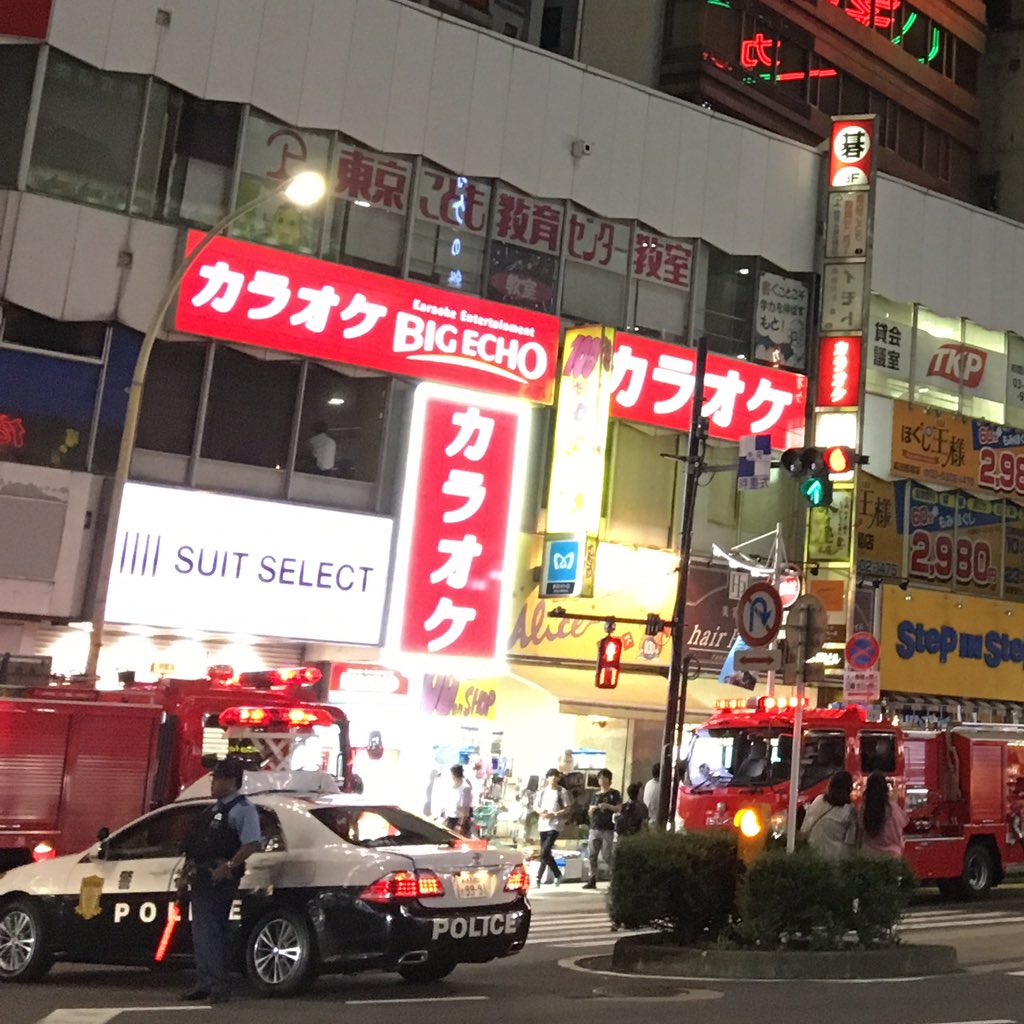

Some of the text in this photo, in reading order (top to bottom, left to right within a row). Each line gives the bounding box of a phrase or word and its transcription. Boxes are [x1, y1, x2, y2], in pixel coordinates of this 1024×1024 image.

[191, 260, 389, 340] カラオケ
[412, 298, 536, 338] Karaoke Entertainment
[392, 310, 548, 381] BIG ECHO
[931, 345, 985, 381] TKP
[609, 344, 794, 434] カラオケ
[423, 407, 496, 653] カラオケ
[173, 544, 374, 593] SUIT SELECT
[507, 598, 602, 651] Alice
[690, 623, 728, 648] hair
[895, 620, 958, 664] Step
[464, 685, 497, 717] SHOP
[431, 913, 518, 941] POLICE
